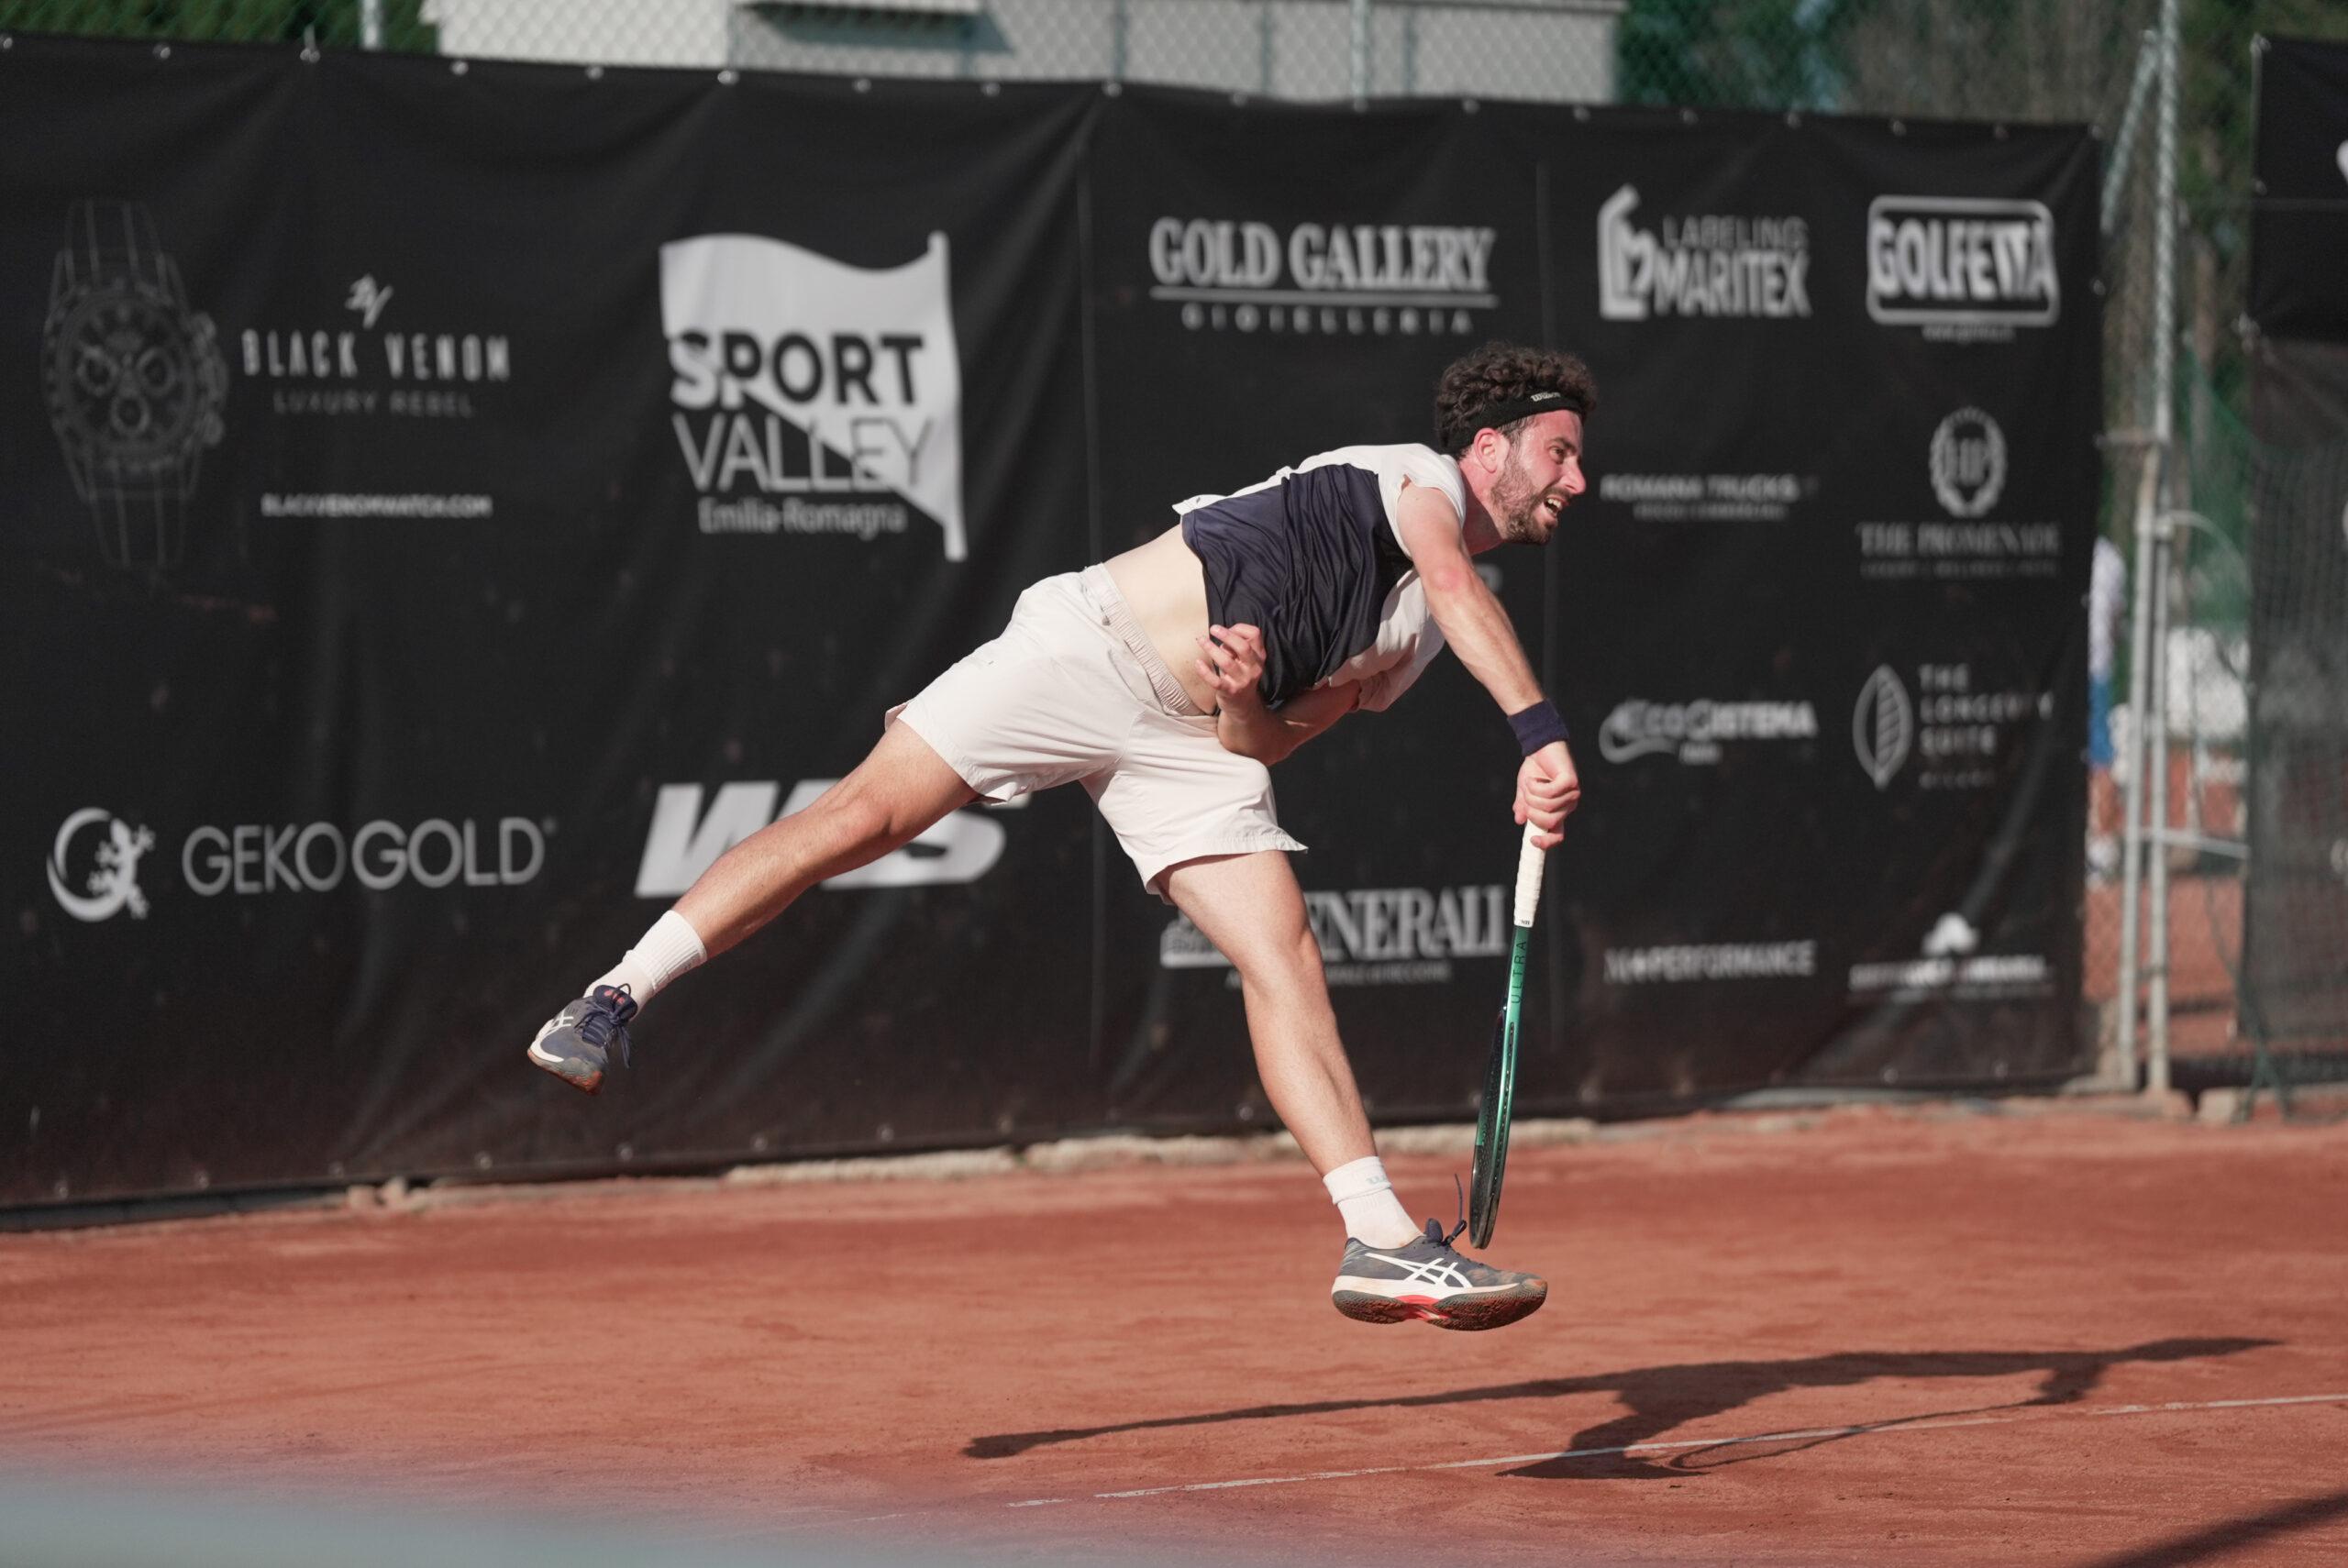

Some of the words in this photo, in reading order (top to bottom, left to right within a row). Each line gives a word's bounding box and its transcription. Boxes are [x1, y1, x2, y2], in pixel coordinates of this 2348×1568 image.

[1148, 216, 1281, 286] GOLD
[1288, 223, 1495, 291] GALLERY
[1662, 215, 1809, 248] LABELING
[1654, 248, 1812, 317] MARITEX
[241, 329, 358, 378] BLACK
[384, 333, 511, 382] VENOM
[668, 328, 925, 410] SPORT
[672, 413, 934, 492] VALLEY
[697, 497, 908, 542] Emilia-Romagna
[182, 816, 547, 897] GEKOGOLD
[1510, 941, 1527, 1004] ULTRA
